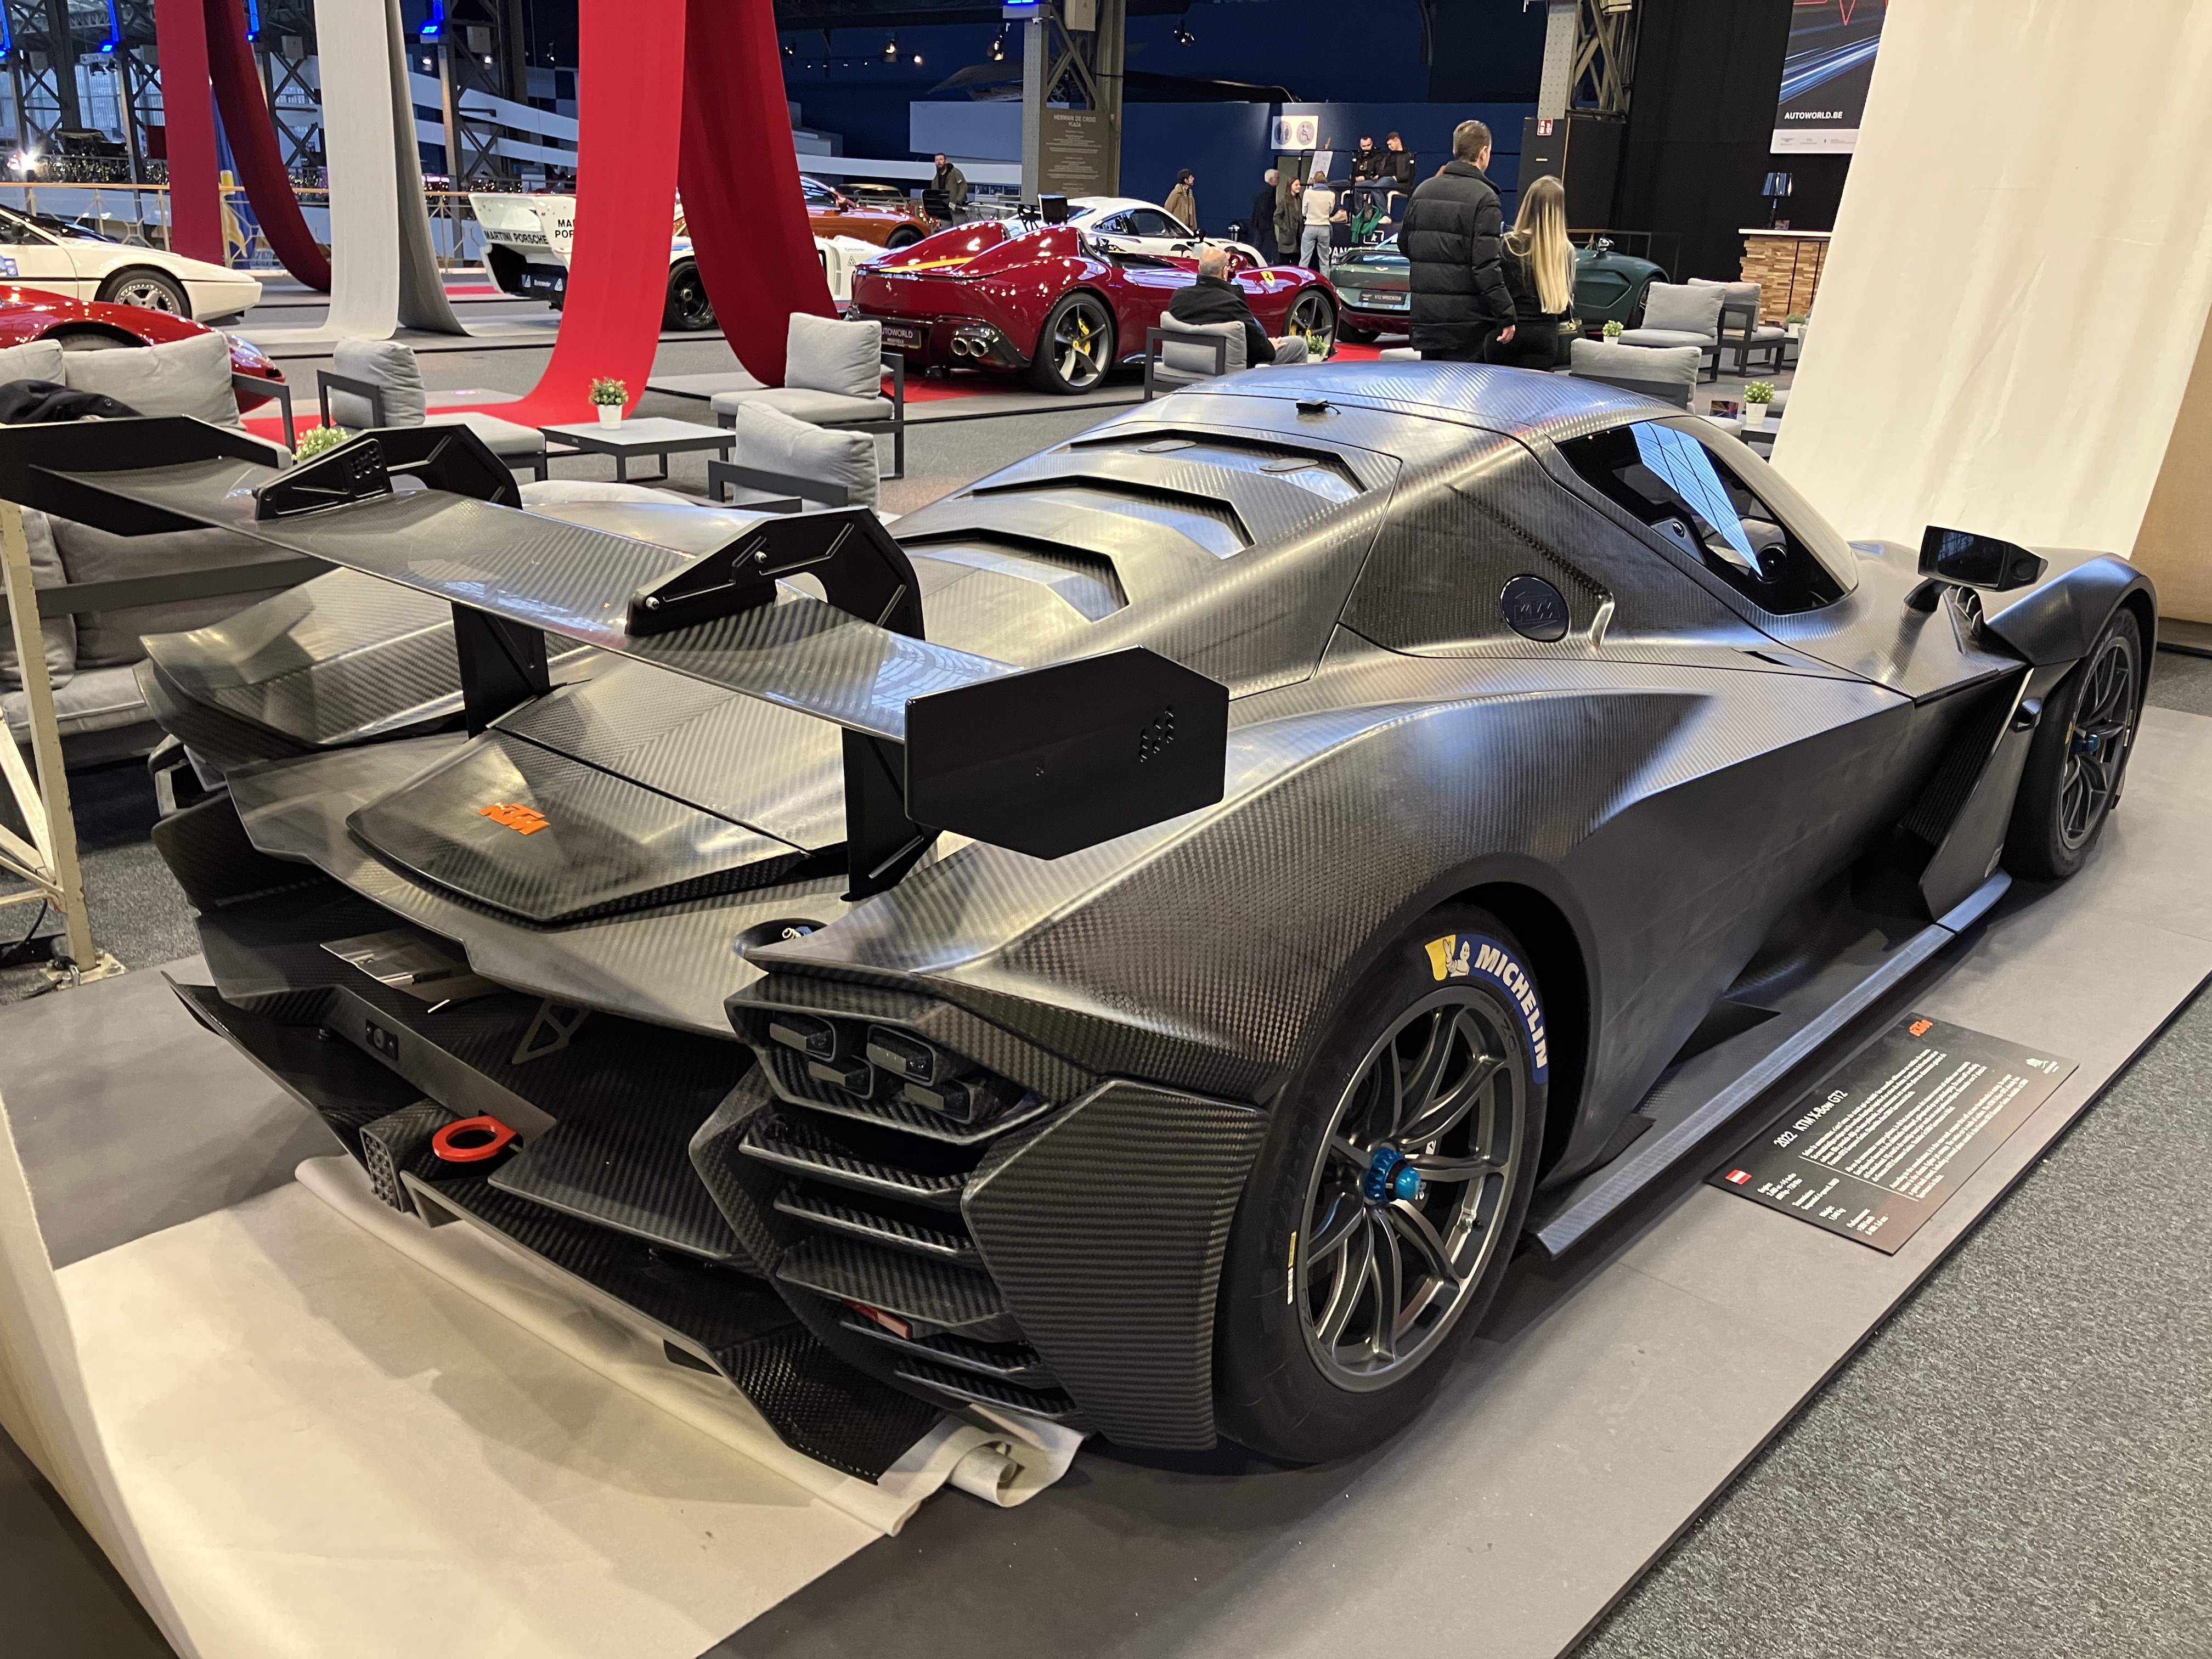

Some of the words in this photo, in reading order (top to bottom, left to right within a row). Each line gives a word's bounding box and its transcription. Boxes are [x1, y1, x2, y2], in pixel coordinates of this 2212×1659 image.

[1784, 111, 1843, 120] AUTOWORLD.BE
[483, 230, 513, 242] MARTINI
[513, 233, 549, 245] PORSCHE
[478, 802, 550, 836] KTM
[1474, 944, 1548, 1068] MICHELIN
[1774, 1131, 1798, 1148] 2022
[1793, 1116, 1816, 1131] KTM
[1807, 1101, 1834, 1119] X-Bow
[1827, 1090, 1848, 1103] GT2
